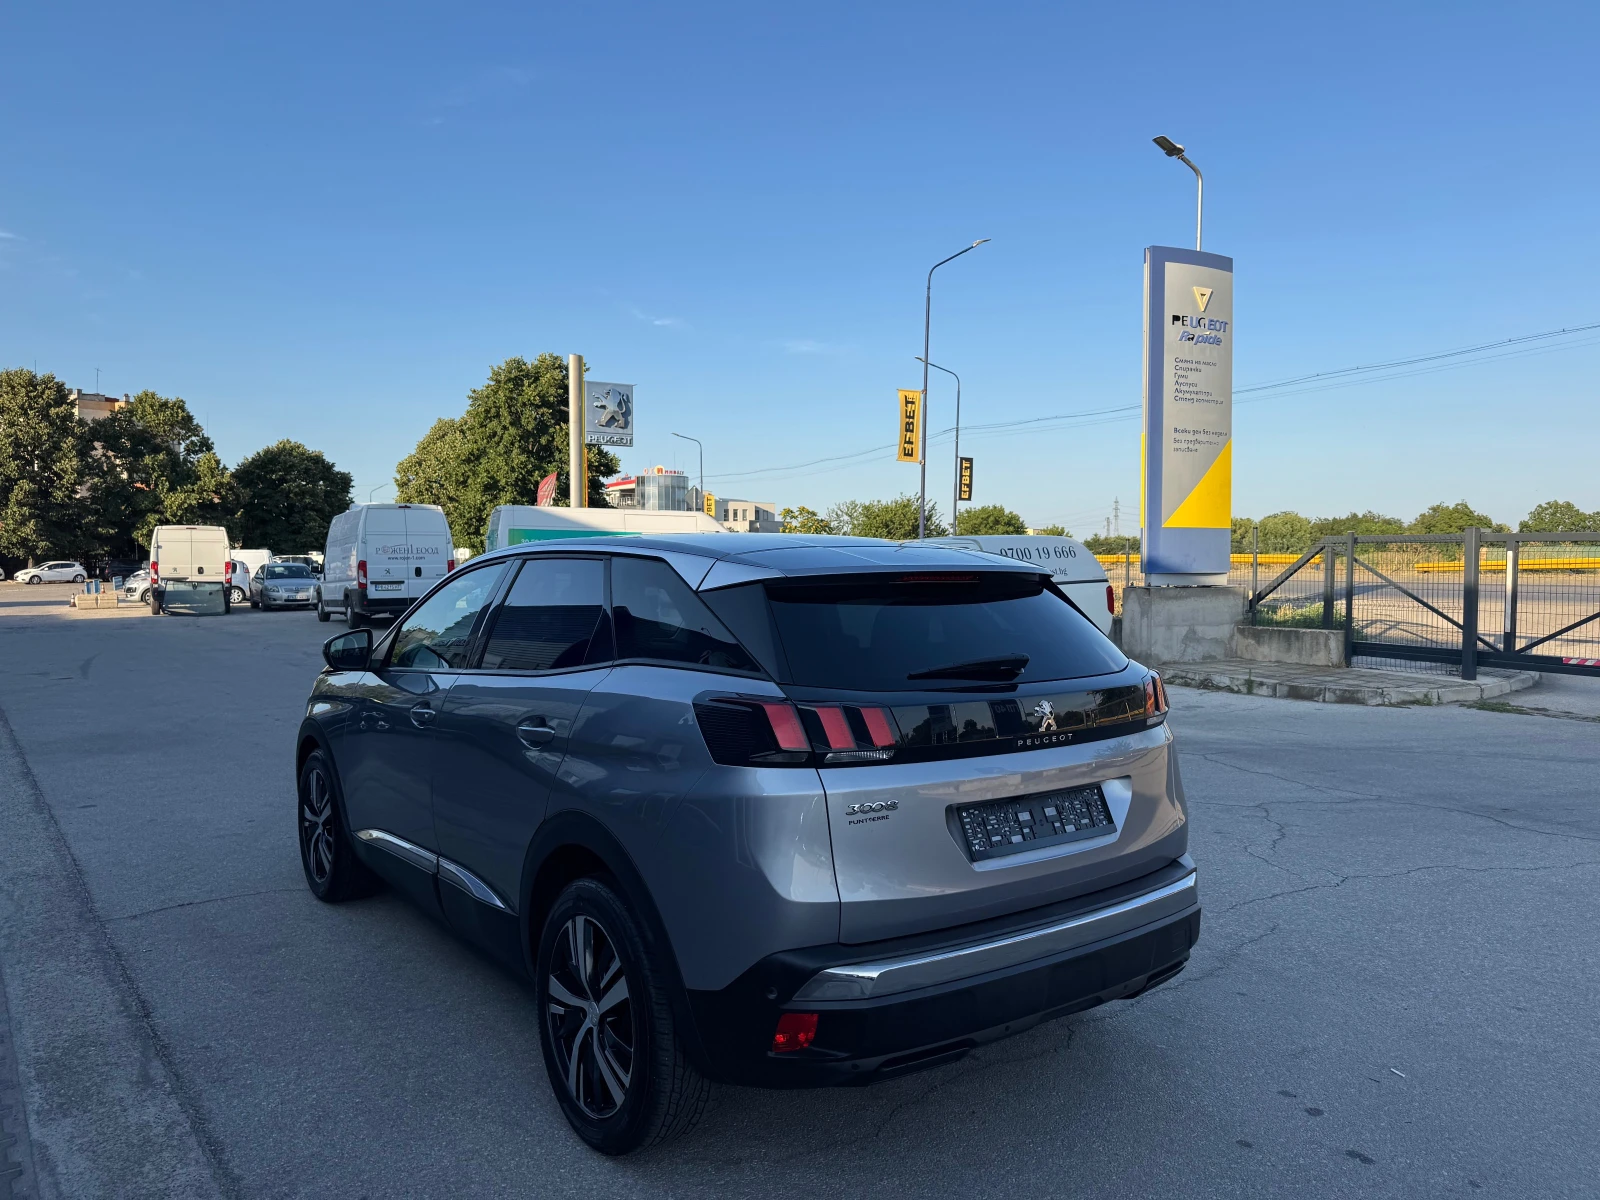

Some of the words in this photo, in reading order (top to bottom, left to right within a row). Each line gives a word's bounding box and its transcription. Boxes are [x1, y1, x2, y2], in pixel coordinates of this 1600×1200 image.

[1172, 315, 1228, 332] PEUGEOT
[1178, 330, 1222, 346] Rapide
[903, 394, 916, 458] EFBET
[588, 434, 632, 445] PEUGEOT
[961, 460, 971, 499] EFBET
[1035, 546, 1050, 559] 19
[1054, 545, 1076, 559] 666
[1017, 733, 1073, 746] PEUGEOT
[846, 800, 899, 815] 3008
